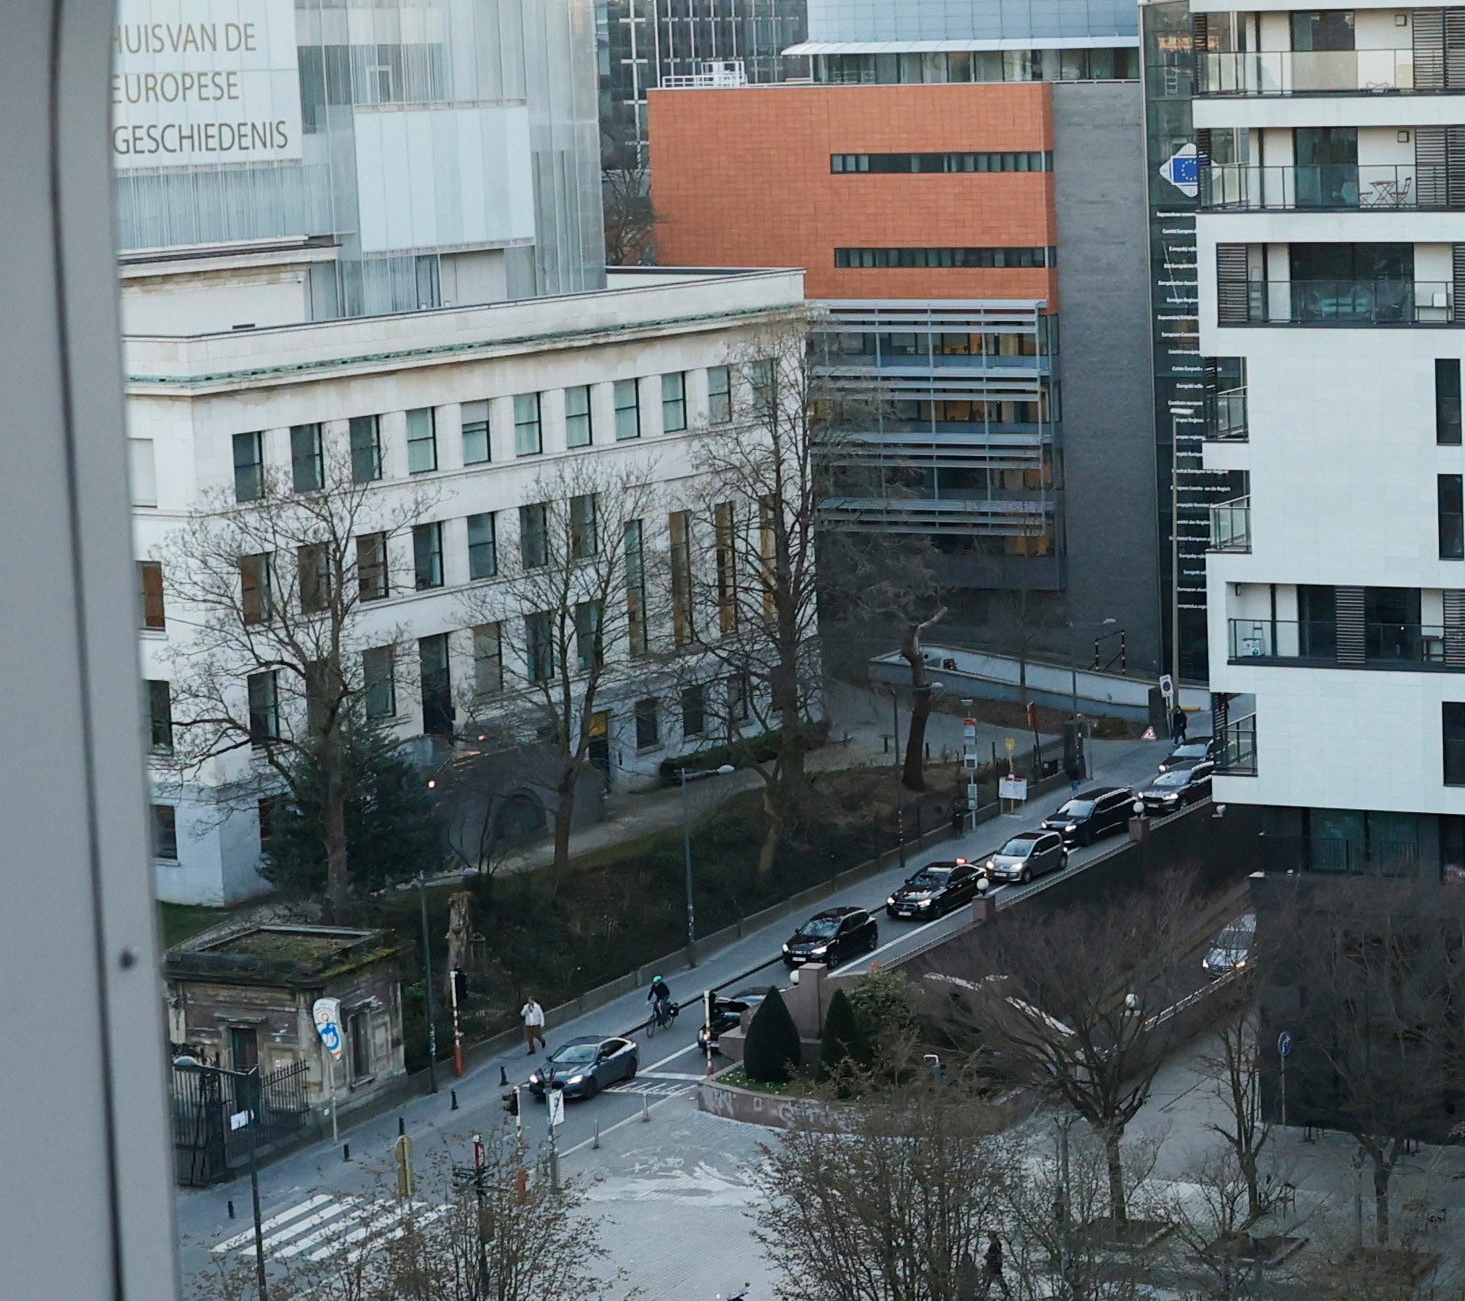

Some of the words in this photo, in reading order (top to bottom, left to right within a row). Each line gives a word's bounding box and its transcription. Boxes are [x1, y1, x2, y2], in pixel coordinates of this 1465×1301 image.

[225, 23, 256, 51] DE
[112, 71, 239, 103] EUROPESE
[112, 120, 288, 154] GESCHIEDENIS
